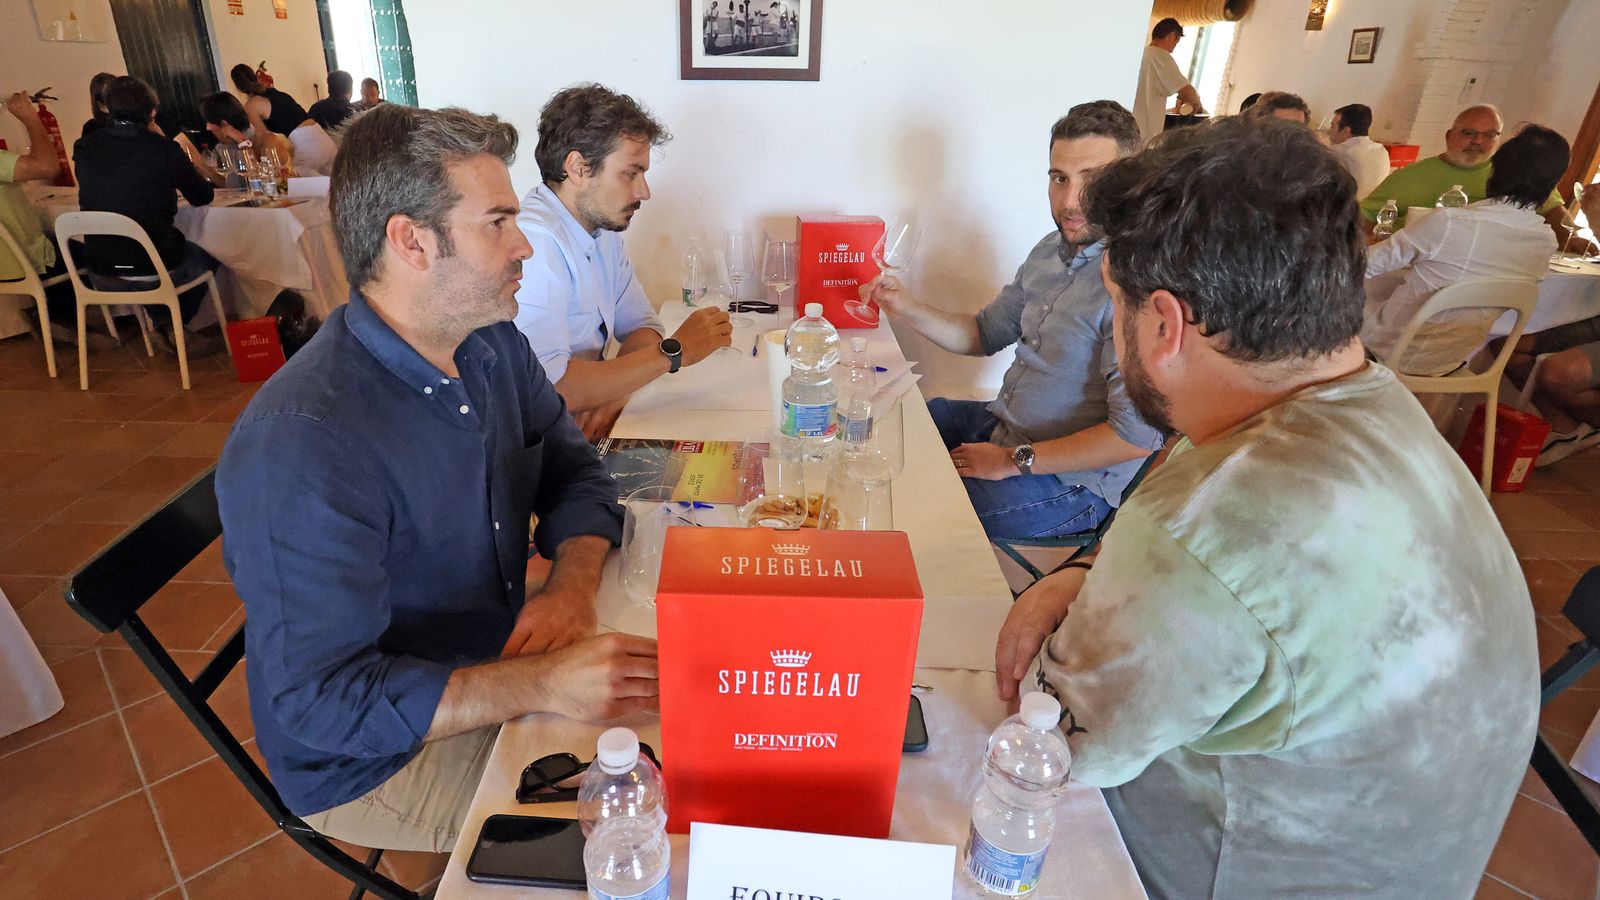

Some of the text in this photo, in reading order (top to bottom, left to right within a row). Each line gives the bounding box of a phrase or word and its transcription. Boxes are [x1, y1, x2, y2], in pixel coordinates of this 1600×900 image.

[818, 252, 865, 263] SPIEGELAU
[721, 556, 863, 578] SPIEGELAU
[718, 669, 861, 697] SPIEGELAU
[734, 733, 838, 748] DEFINITION
